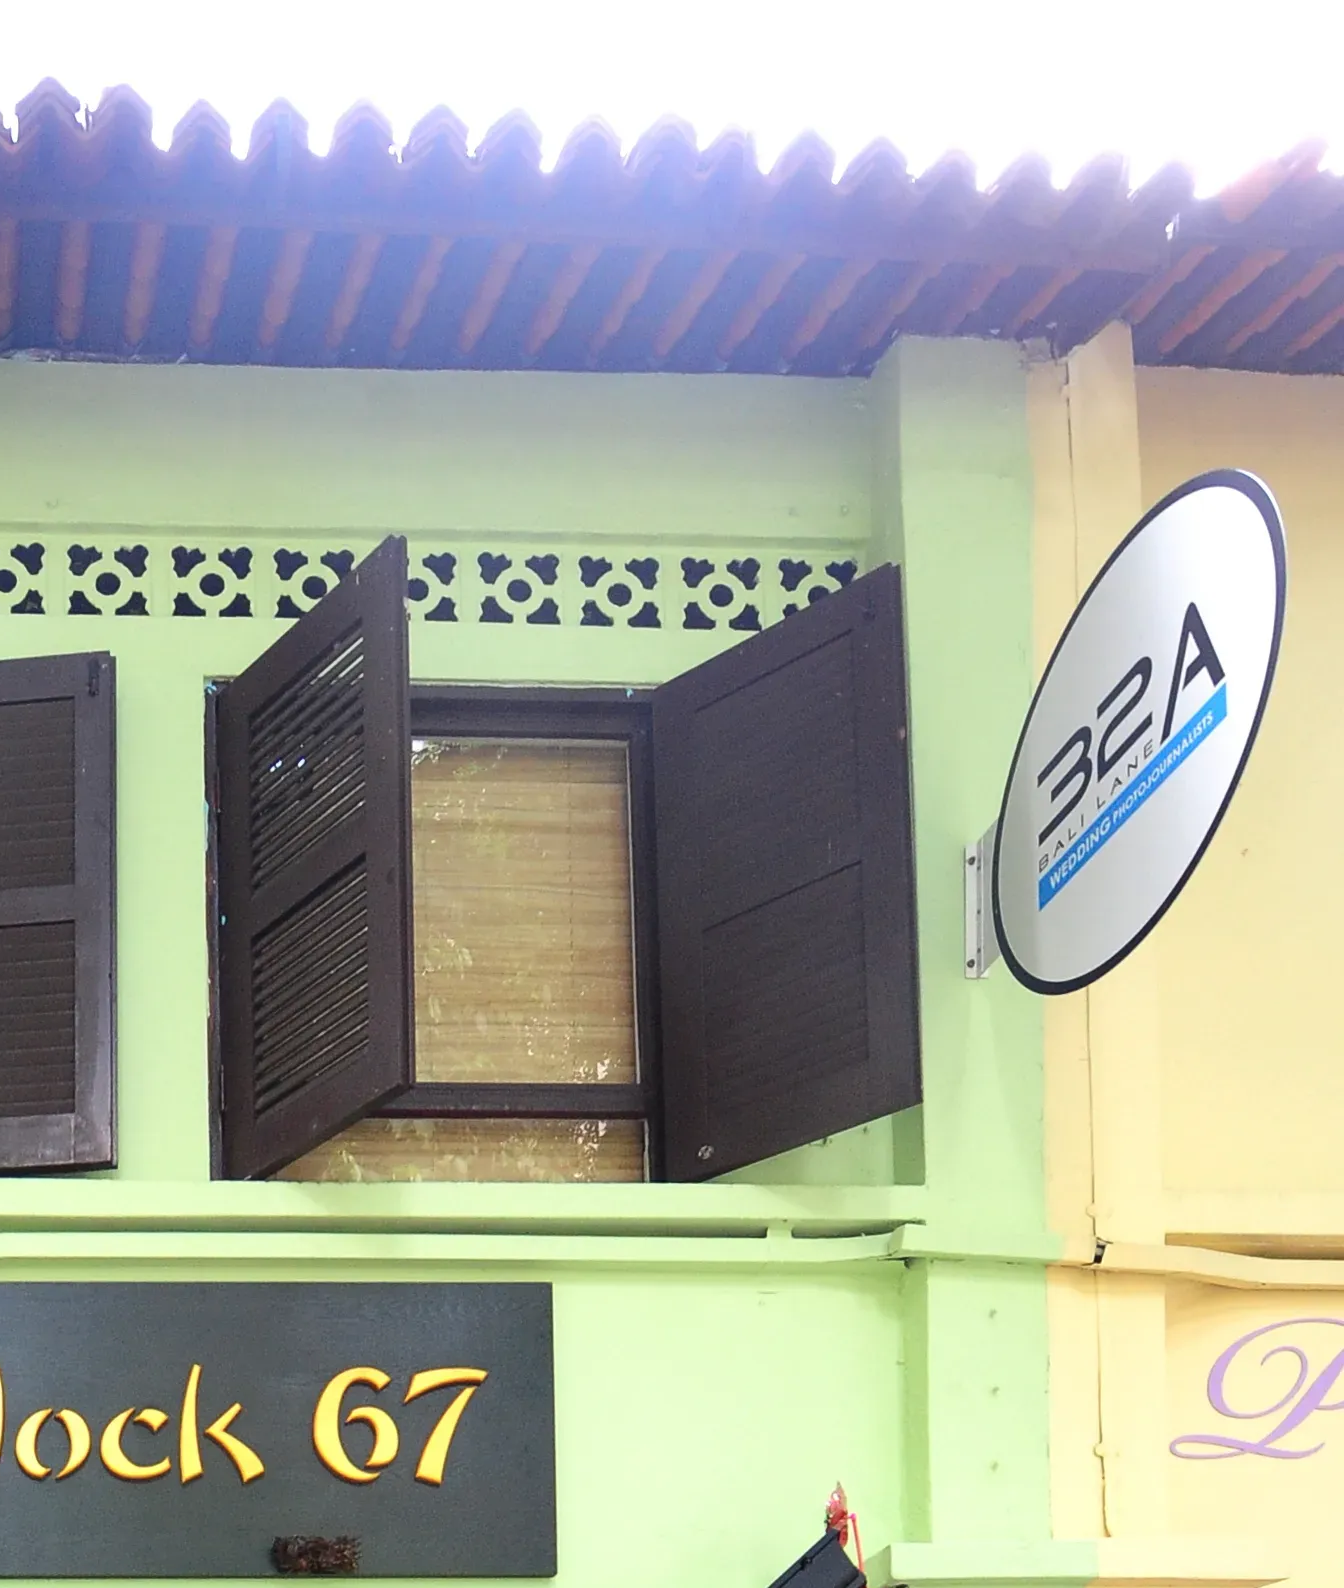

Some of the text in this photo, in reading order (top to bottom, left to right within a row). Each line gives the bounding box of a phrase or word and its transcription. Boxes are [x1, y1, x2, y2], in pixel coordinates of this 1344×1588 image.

[1037, 601, 1226, 847] 32A
[1049, 710, 1214, 890] WEDDING PHOTOJOURNALISTS
[1038, 738, 1154, 874] BALI LANE
[311, 1365, 489, 1487] 67
